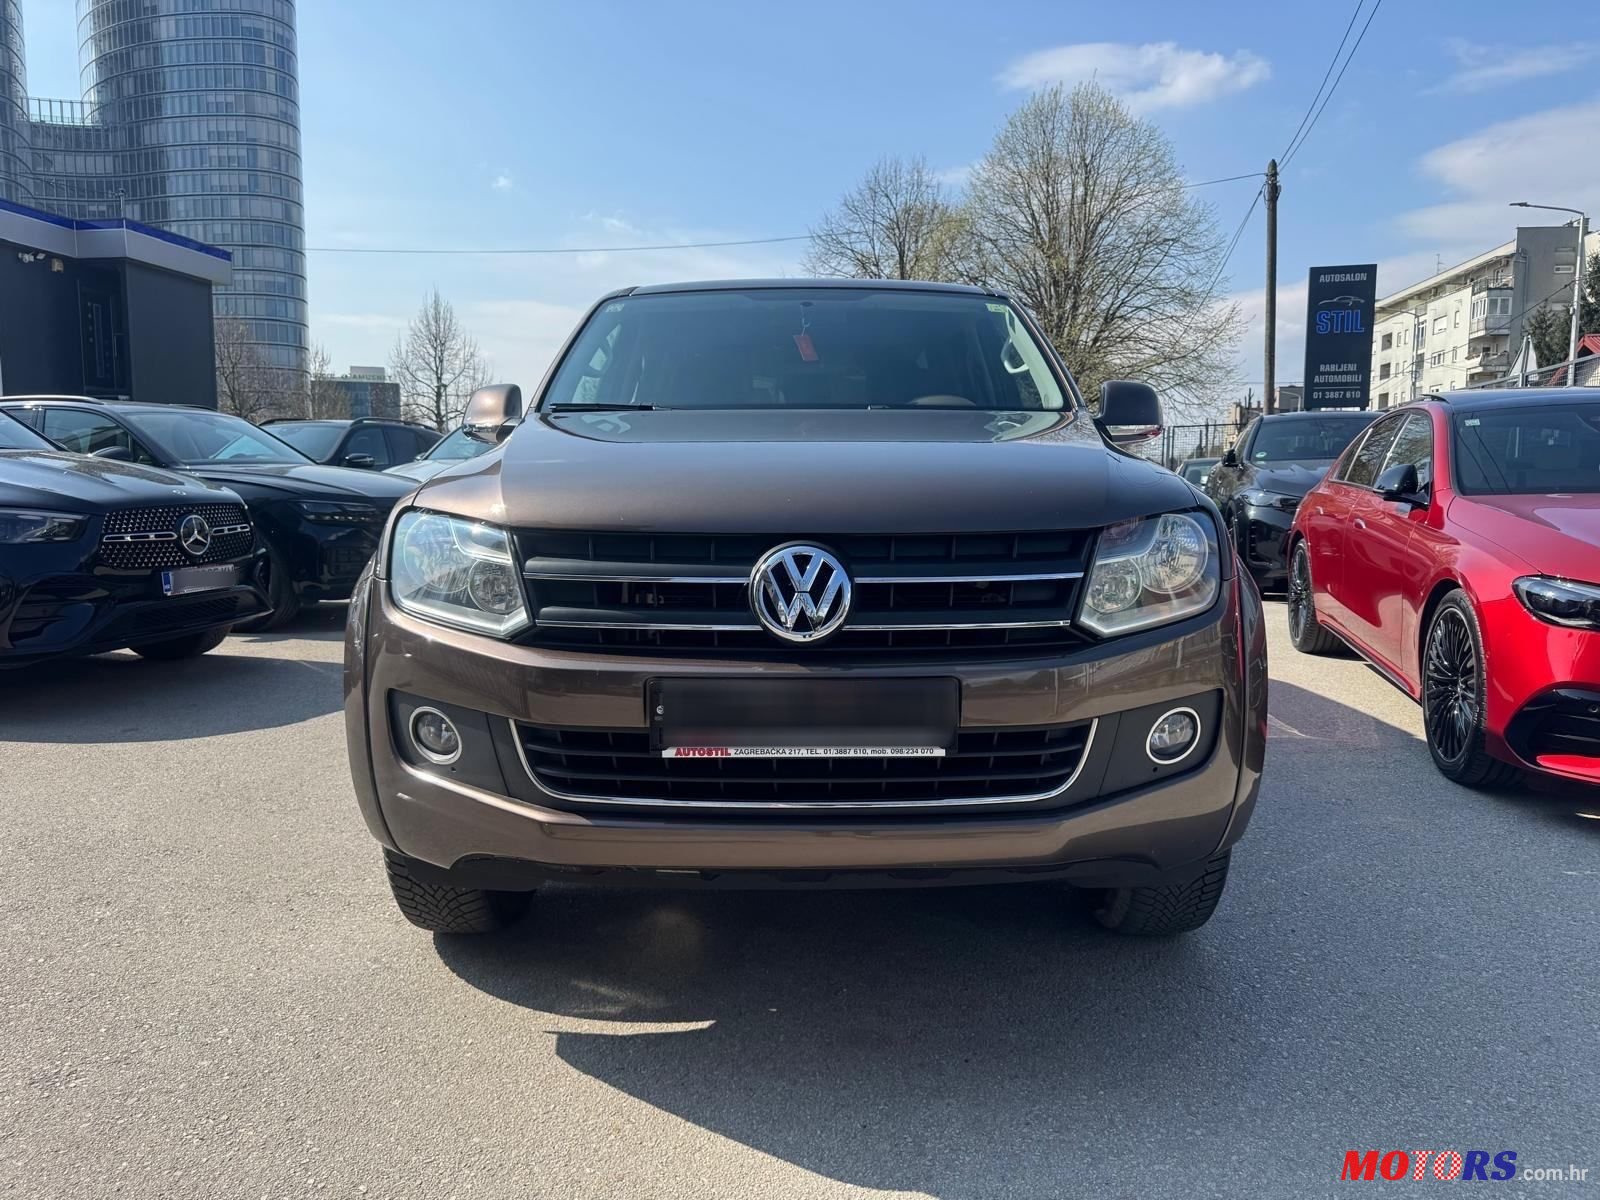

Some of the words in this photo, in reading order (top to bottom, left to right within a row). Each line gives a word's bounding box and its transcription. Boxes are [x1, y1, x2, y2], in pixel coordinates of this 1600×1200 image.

[1320, 272, 1367, 283] AUTOSALON
[1316, 309, 1365, 334] STIL
[1320, 363, 1357, 372] RABLJENI
[1313, 374, 1362, 383] AUTOMOBILI
[1312, 391, 1322, 399] 01
[675, 748, 731, 757] AUTOSTIL
[734, 747, 786, 756] ZAGREBAČKA
[788, 748, 803, 756] 217,
[853, 748, 869, 756] 610,
